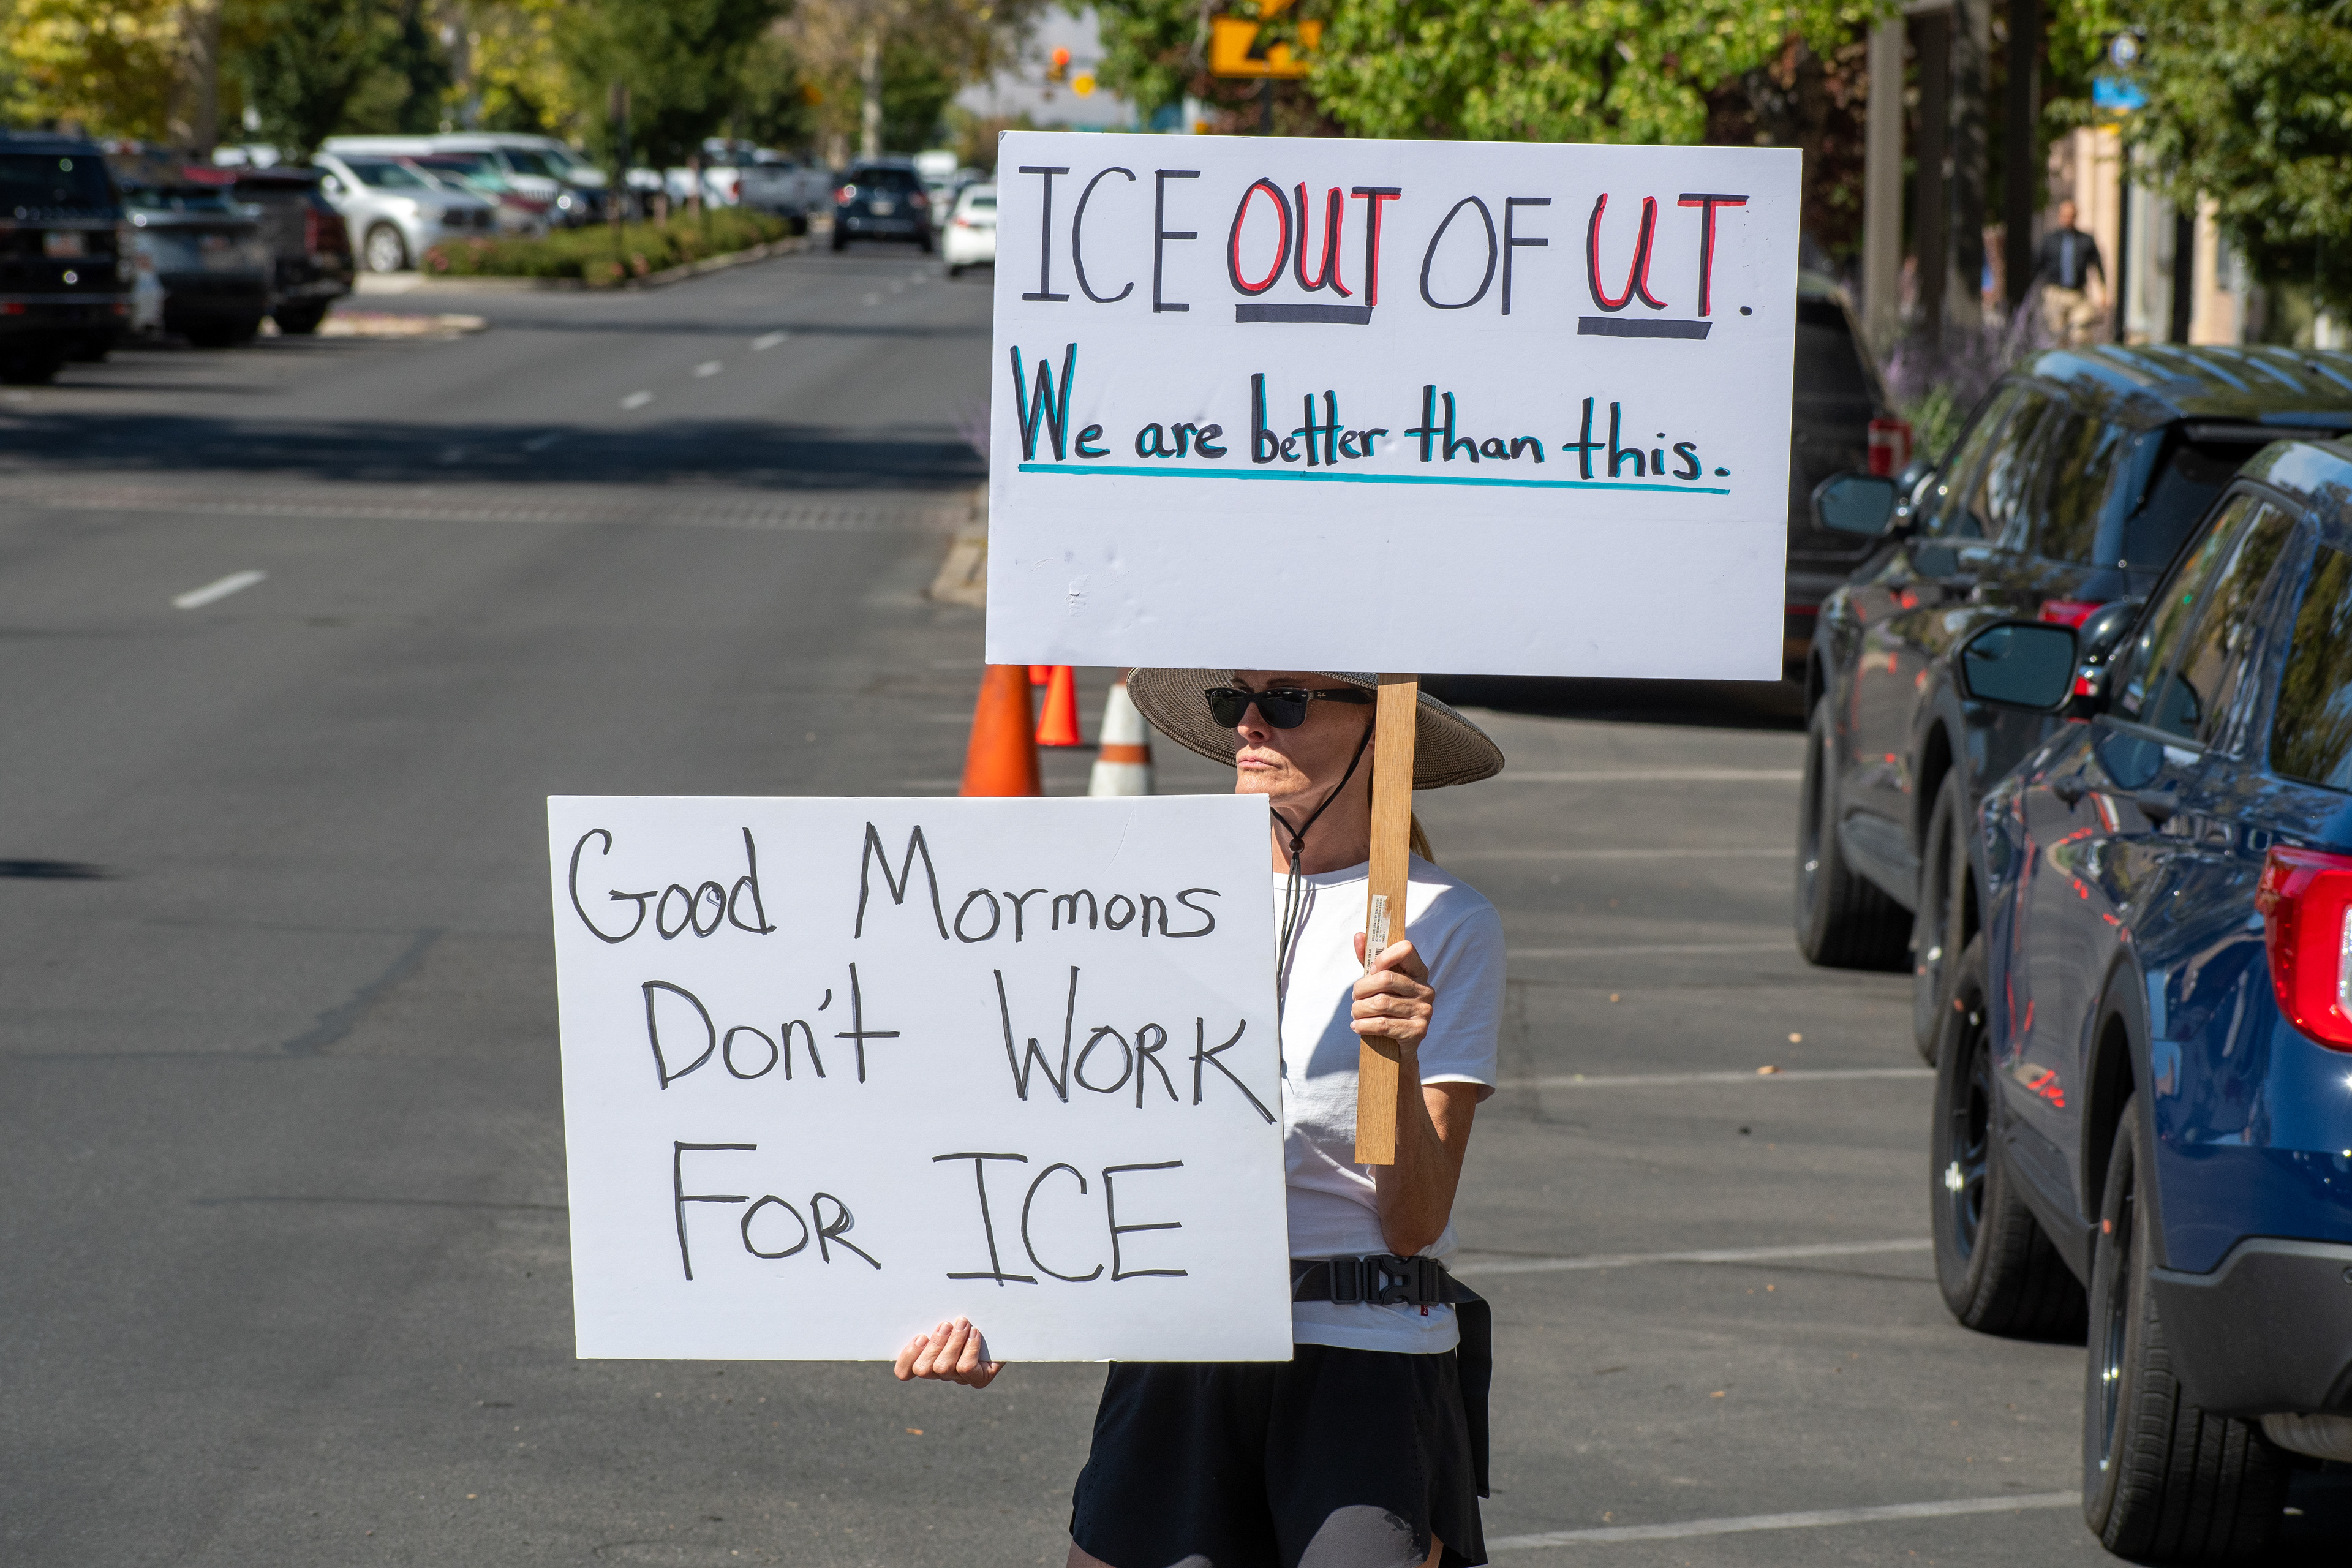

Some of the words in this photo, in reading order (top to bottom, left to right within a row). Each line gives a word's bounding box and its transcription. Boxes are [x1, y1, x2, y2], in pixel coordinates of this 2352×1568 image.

[1018, 165, 1201, 314] ICE
[1227, 176, 1403, 307] OUT
[1419, 195, 1552, 316] OF
[1586, 192, 1753, 317] UT.
[1009, 342, 1111, 463] We
[1134, 422, 1228, 459] are
[1250, 372, 1389, 467] better
[1404, 384, 1545, 464] than
[1562, 396, 1731, 481] this.
[568, 827, 777, 944] Good
[854, 821, 1221, 944] Mormons
[641, 962, 900, 1090] Don't
[993, 965, 1278, 1125] WORK
[673, 1140, 882, 1281] FOR
[932, 1152, 1189, 1287] ICE
